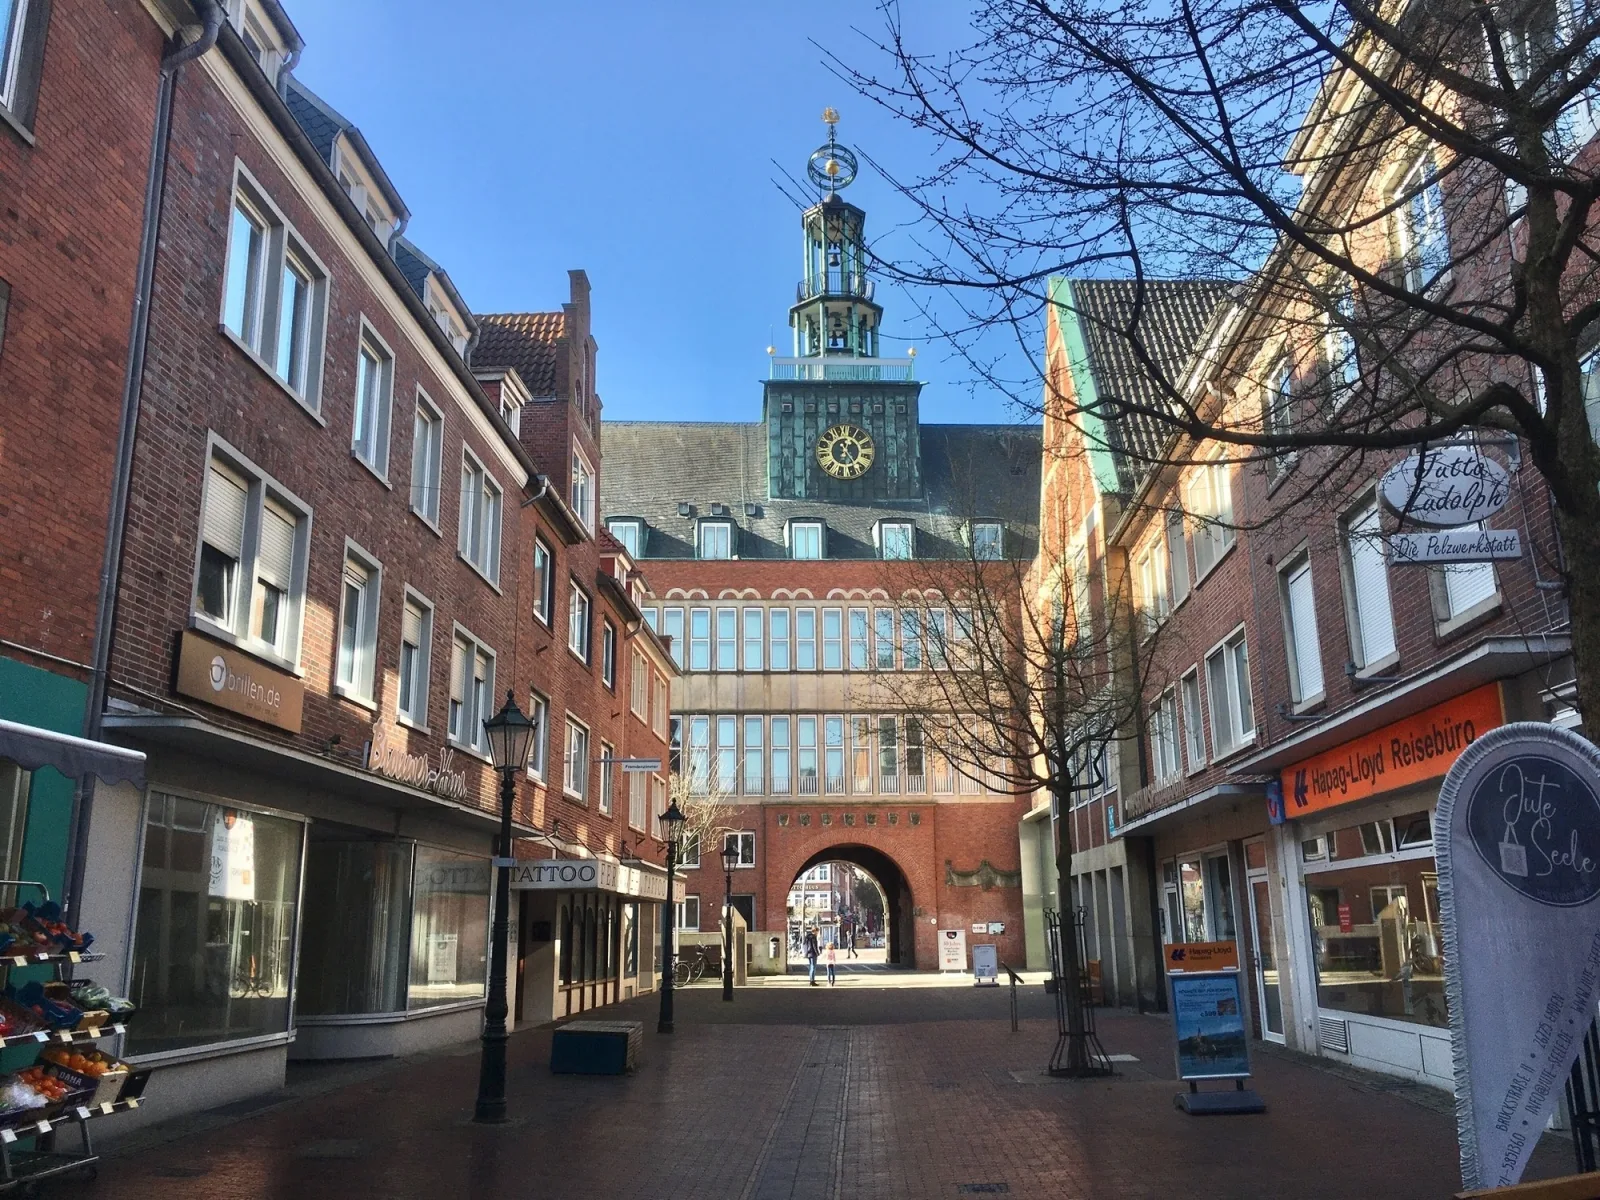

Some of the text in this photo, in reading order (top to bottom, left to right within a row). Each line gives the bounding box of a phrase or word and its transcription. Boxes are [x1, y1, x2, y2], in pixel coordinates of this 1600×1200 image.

[1414, 453, 1485, 479] Jutta
[1398, 533, 1517, 559] Die Pelzwerkstatt
[228, 667, 280, 708] brillen.de
[1311, 717, 1475, 799] Hapag-Lloyd Reisebüro
[1500, 763, 1560, 827] Jute
[1531, 817, 1596, 876] Seele
[509, 865, 596, 882] TATTOO
[1189, 946, 1232, 955] Hapag-Lloyd
[1533, 1022, 1553, 1049] 26725
[1544, 992, 1564, 1023] EMDEN
